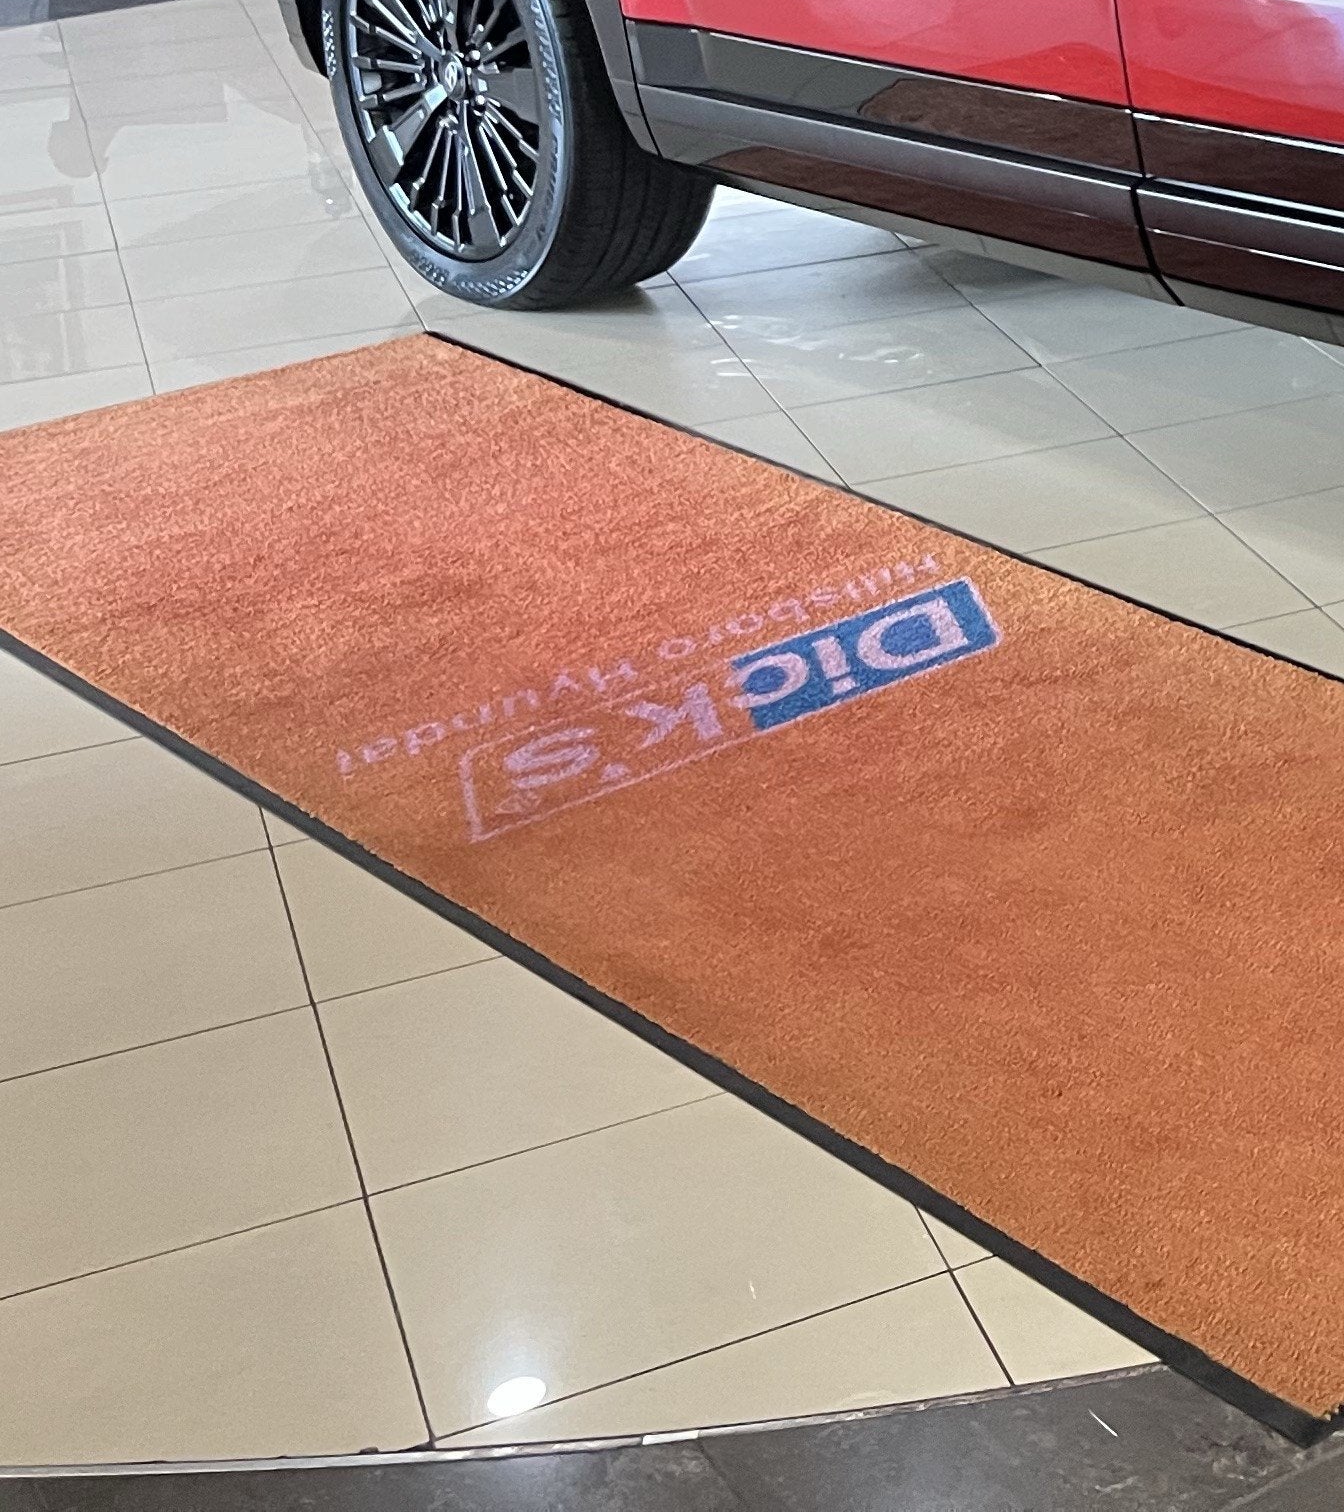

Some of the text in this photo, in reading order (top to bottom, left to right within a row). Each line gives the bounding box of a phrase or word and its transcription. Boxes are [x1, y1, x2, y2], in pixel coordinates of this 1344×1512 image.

[336, 555, 940, 778] Hillsboro Hyundai
[503, 596, 971, 791] Dick's
